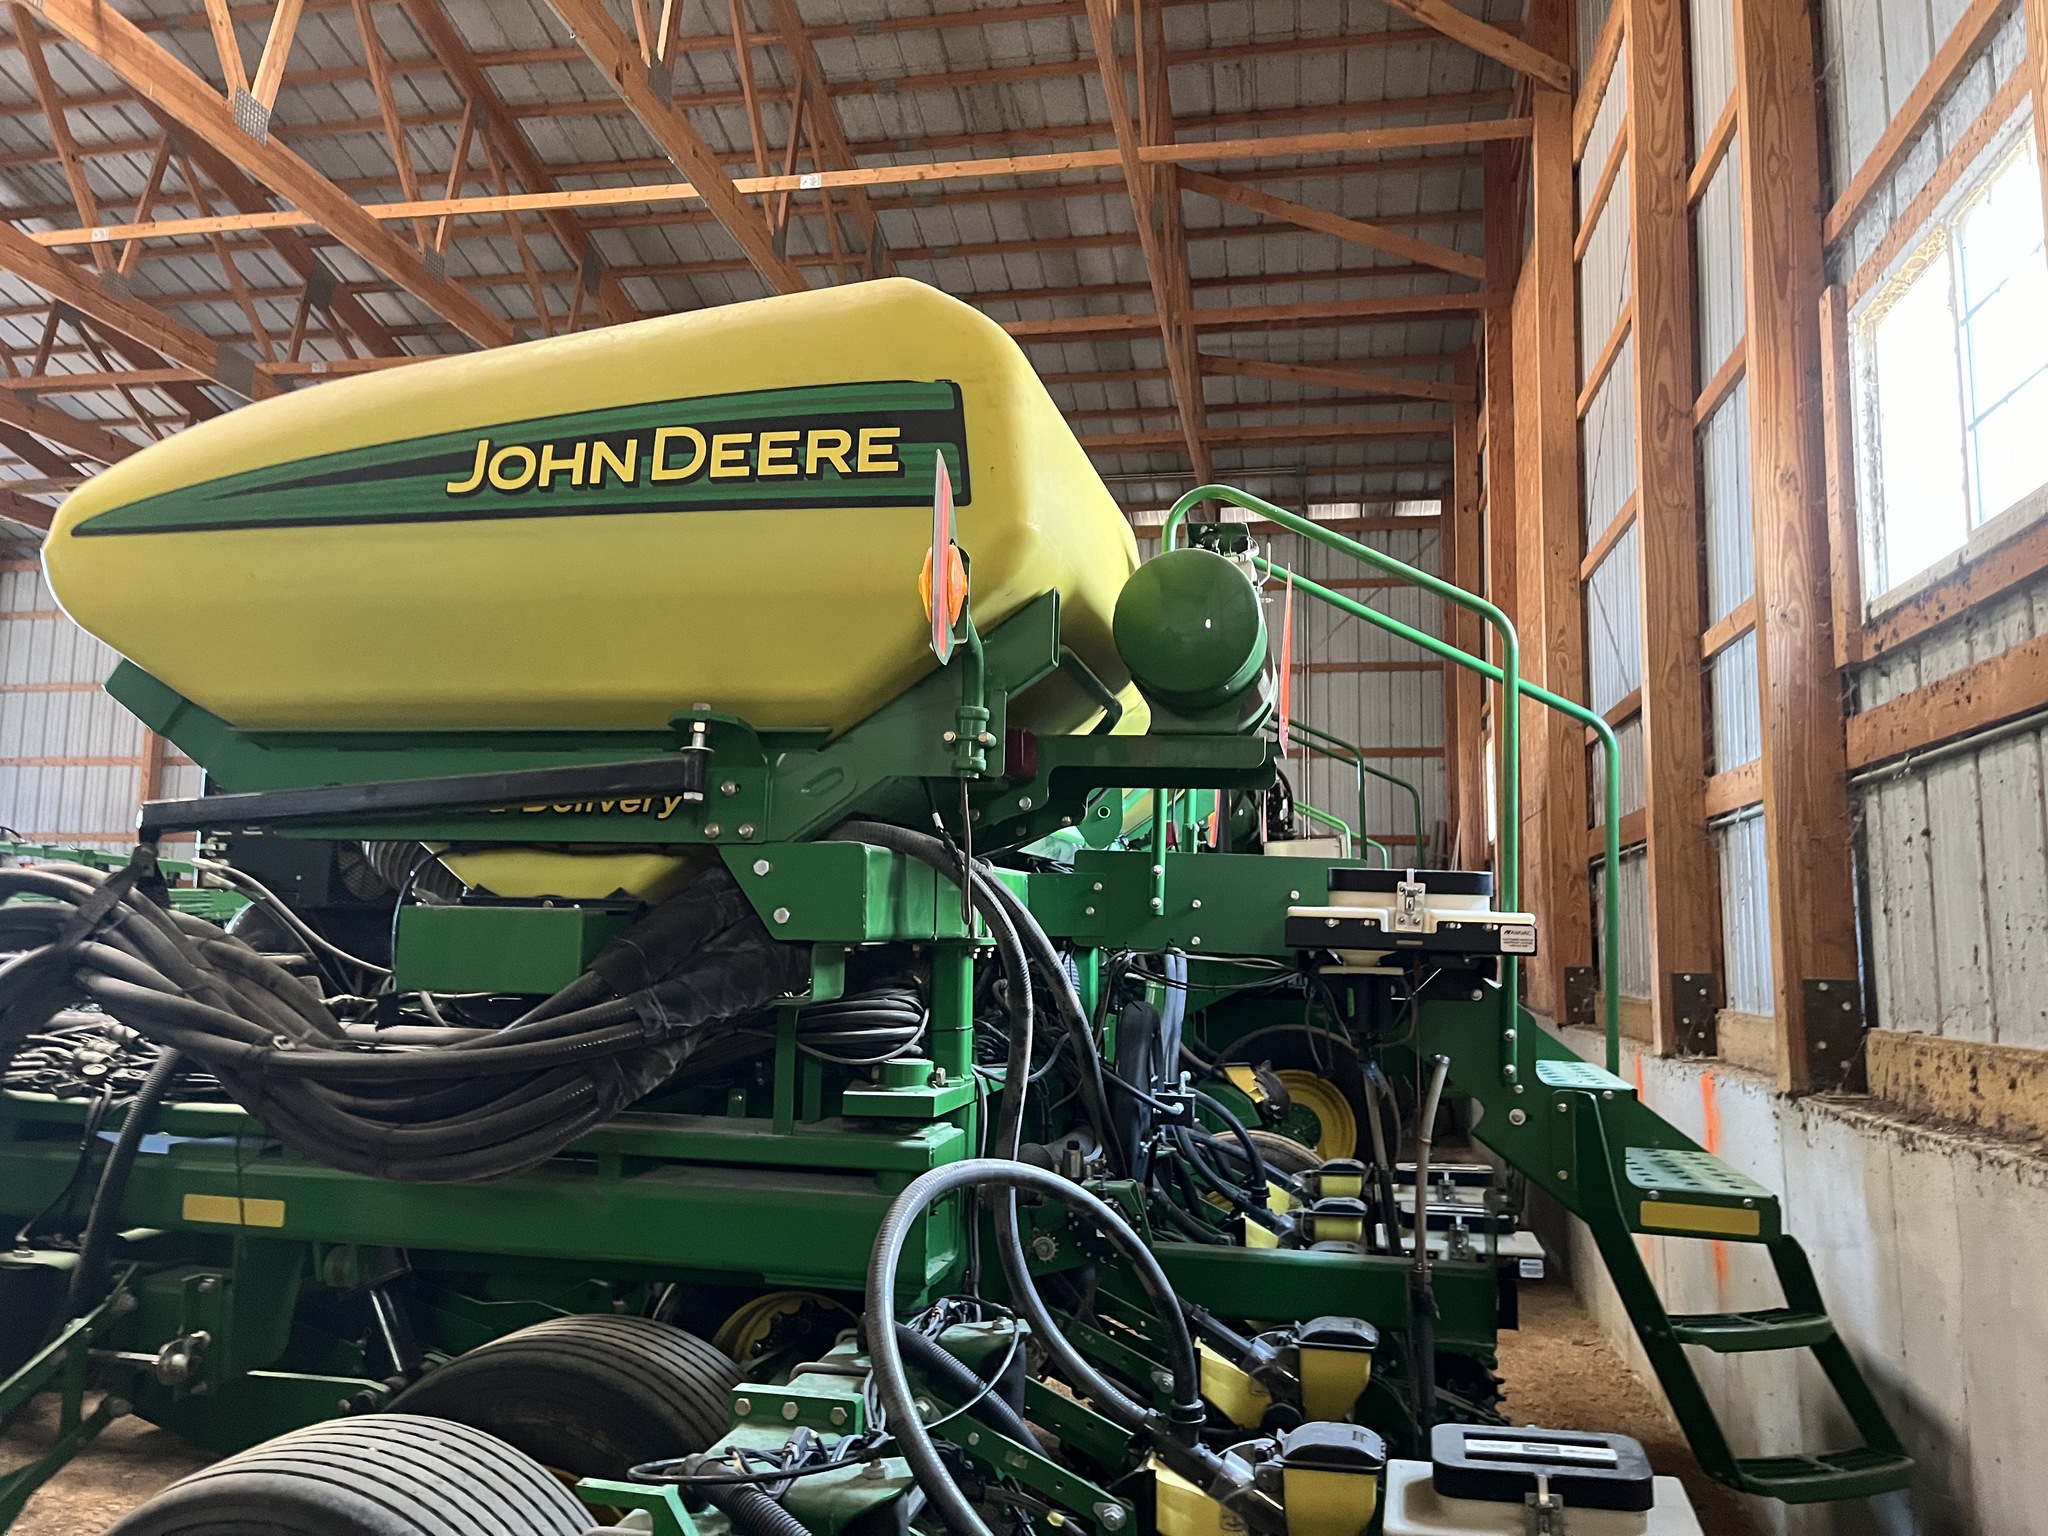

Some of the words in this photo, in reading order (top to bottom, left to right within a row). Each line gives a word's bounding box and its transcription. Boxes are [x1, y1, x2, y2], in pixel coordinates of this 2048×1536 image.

[446, 438, 638, 493] JOHN
[650, 426, 901, 481] DEERE
[522, 795, 683, 819] very
